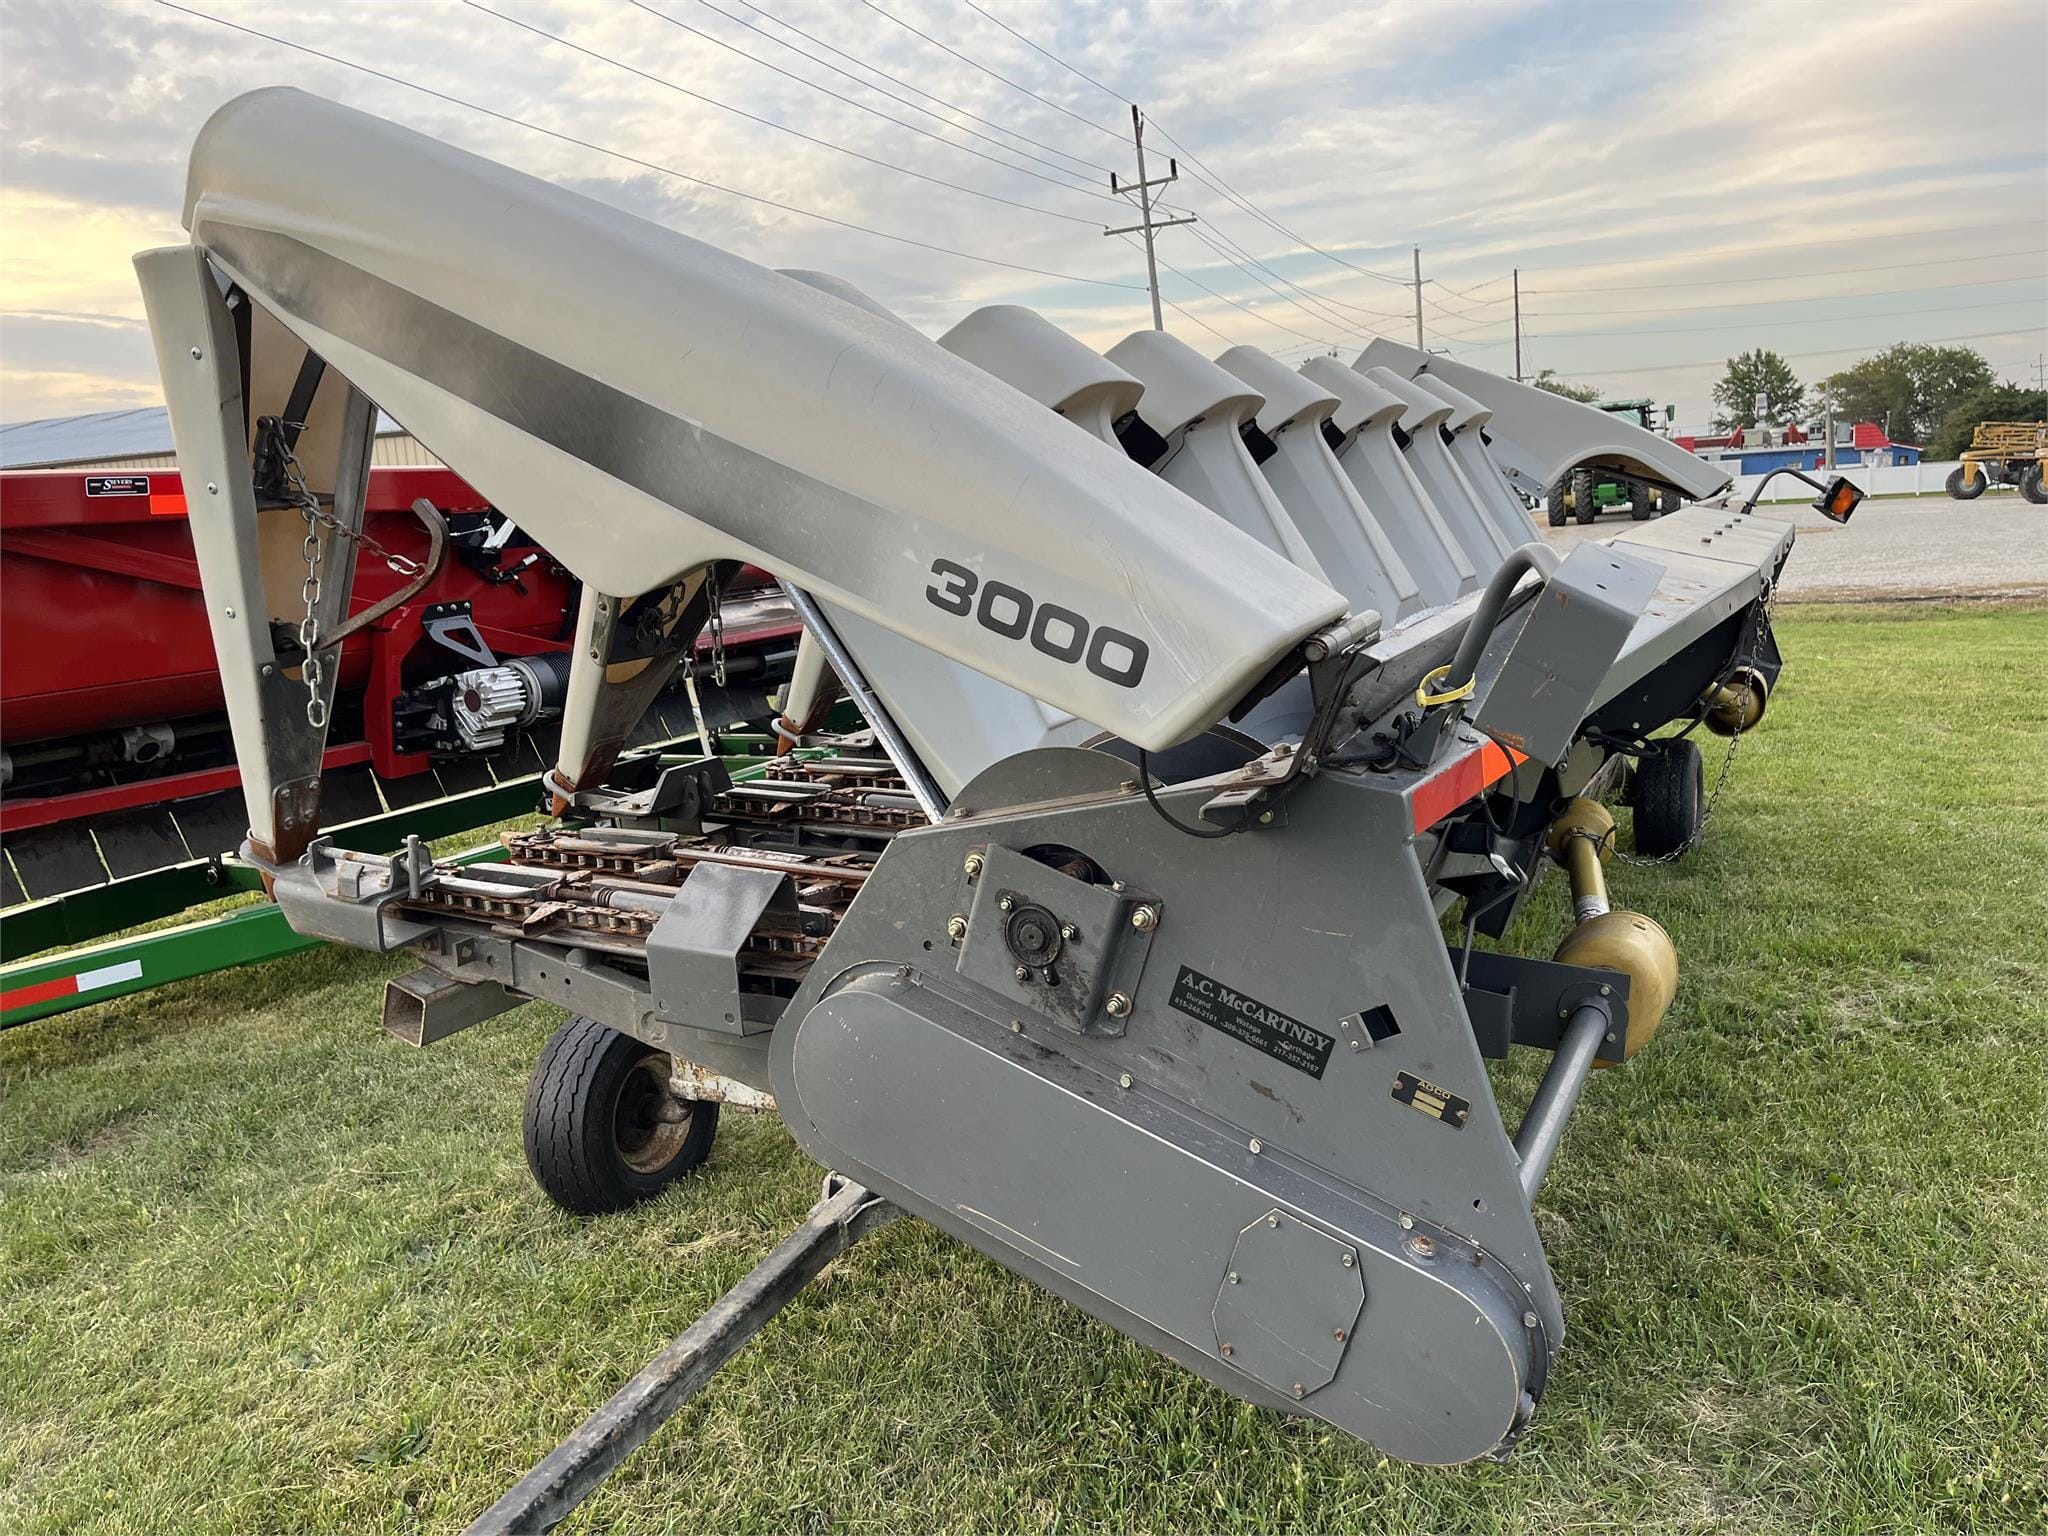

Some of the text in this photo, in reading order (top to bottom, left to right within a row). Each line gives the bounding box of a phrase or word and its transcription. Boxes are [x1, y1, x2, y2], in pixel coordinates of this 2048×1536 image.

[926, 558, 1149, 689] 3000
[1181, 973, 1330, 1052] A.C. McCARTNEY
[1186, 992, 1316, 1061] Durand Wataga Carthage
[1417, 1080, 1451, 1100] AGCO
